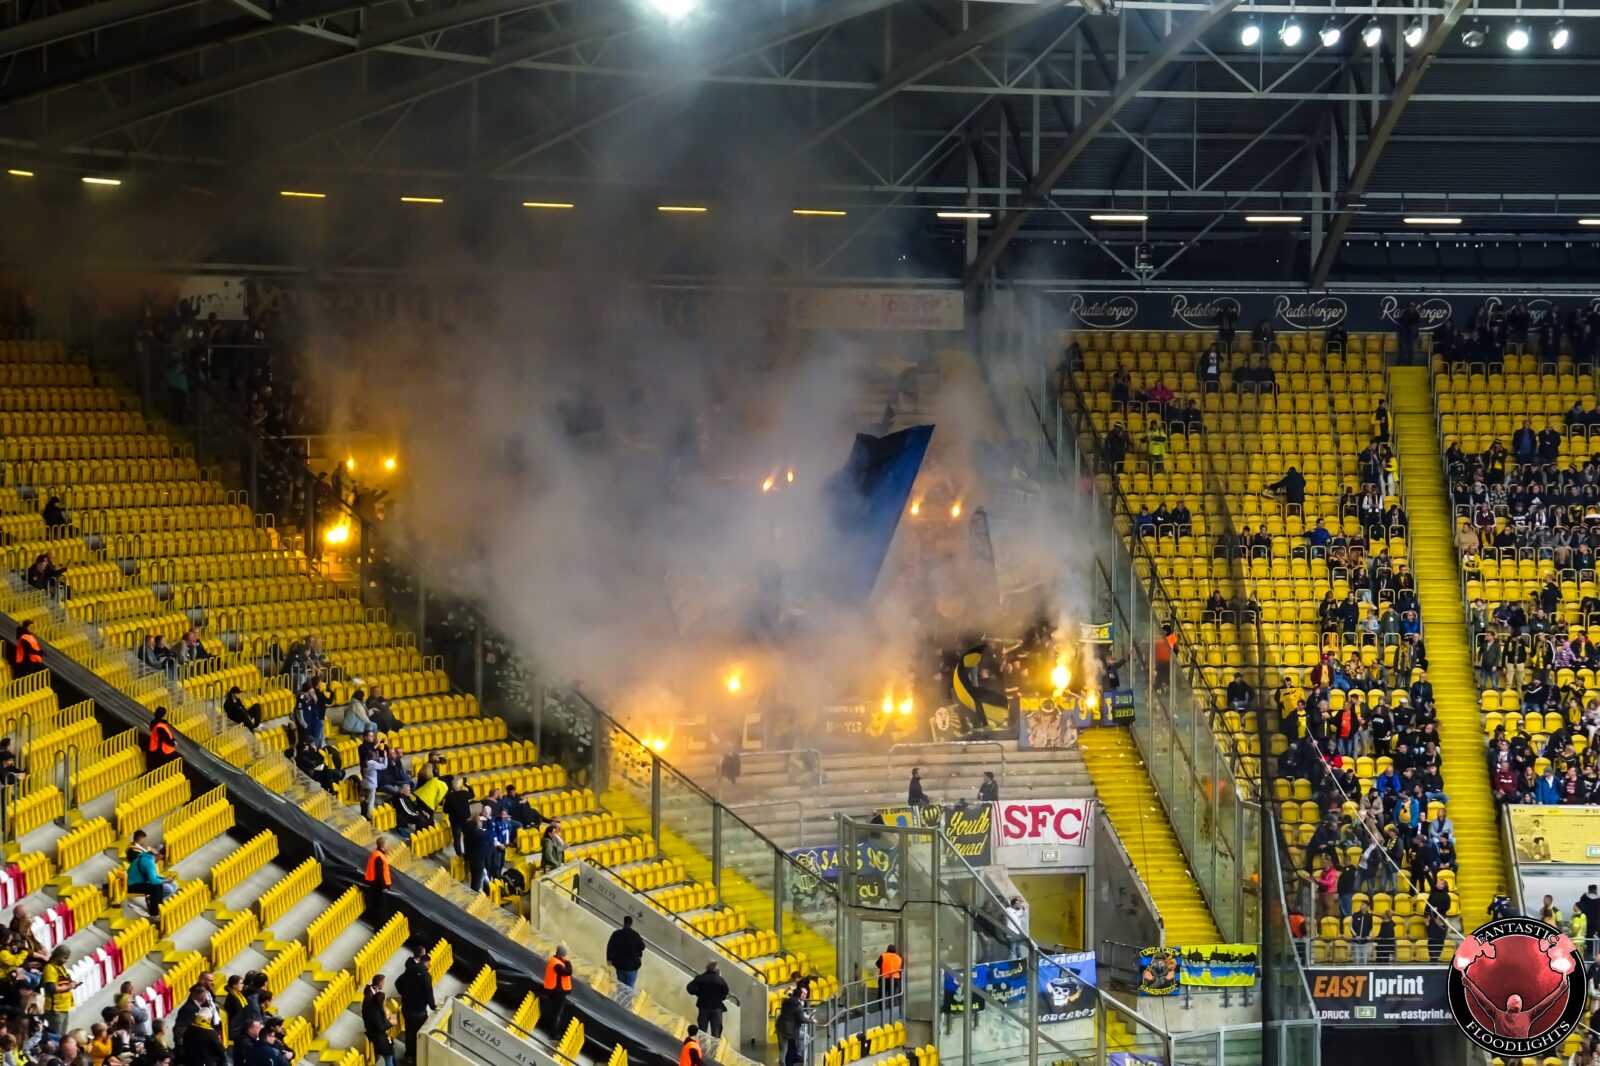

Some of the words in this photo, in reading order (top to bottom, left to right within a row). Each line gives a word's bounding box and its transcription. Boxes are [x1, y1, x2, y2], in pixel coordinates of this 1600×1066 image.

[1069, 294, 1136, 323] Radeberger
[1274, 295, 1345, 323] Radeberger
[946, 806, 990, 837] Youth
[1003, 804, 1083, 840] SFC
[1313, 975, 1367, 998] EAST
[1375, 974, 1424, 998] print
